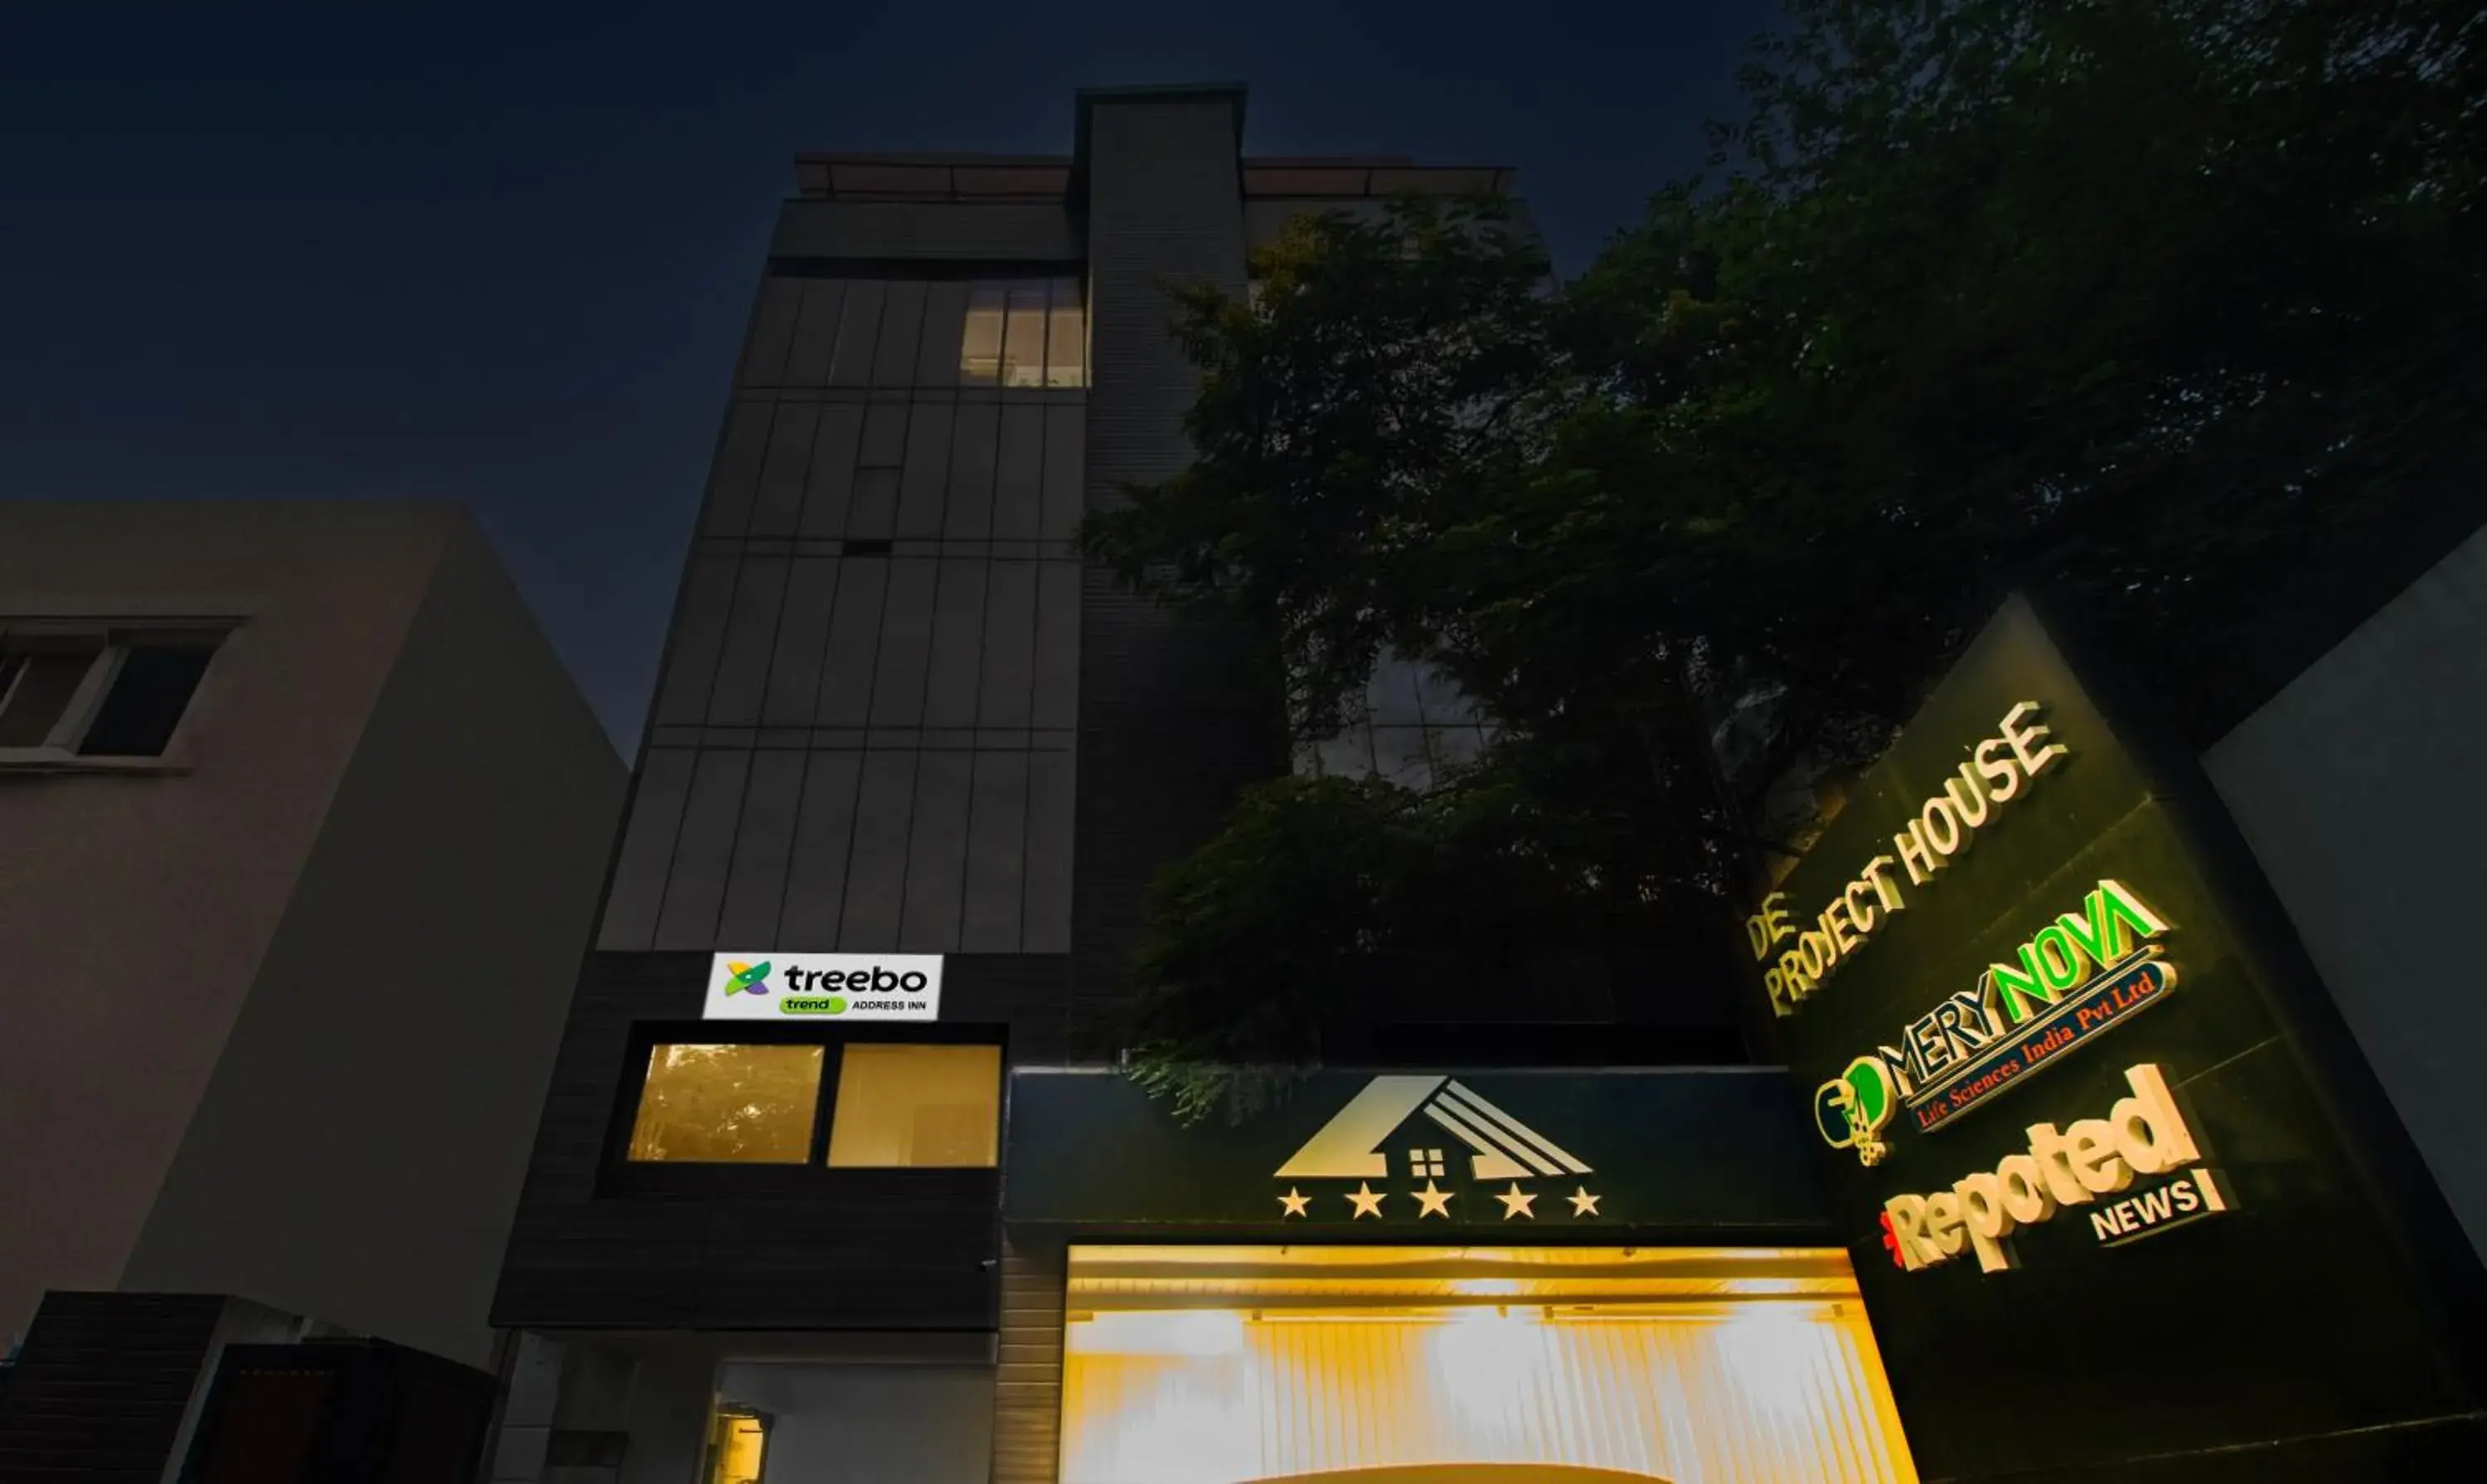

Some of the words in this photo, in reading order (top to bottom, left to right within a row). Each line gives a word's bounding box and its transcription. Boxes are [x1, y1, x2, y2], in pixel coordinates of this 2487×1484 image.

[1764, 855, 1903, 1018] PROJECT
[1894, 701, 2068, 885] HOUSE
[1746, 892, 1796, 961] DE
[783, 965, 928, 992] treebo
[785, 998, 830, 1011] trend
[851, 1001, 905, 1011] ADDRESS
[908, 1001, 927, 1011] INN
[1917, 1102, 1948, 1128] Life
[1949, 1059, 2021, 1108] Sciences
[2020, 1026, 2075, 1064] India
[2076, 1000, 2113, 1031] Pvt
[2111, 971, 2155, 1009] Ltd
[2089, 1181, 2202, 1242] NEWS
